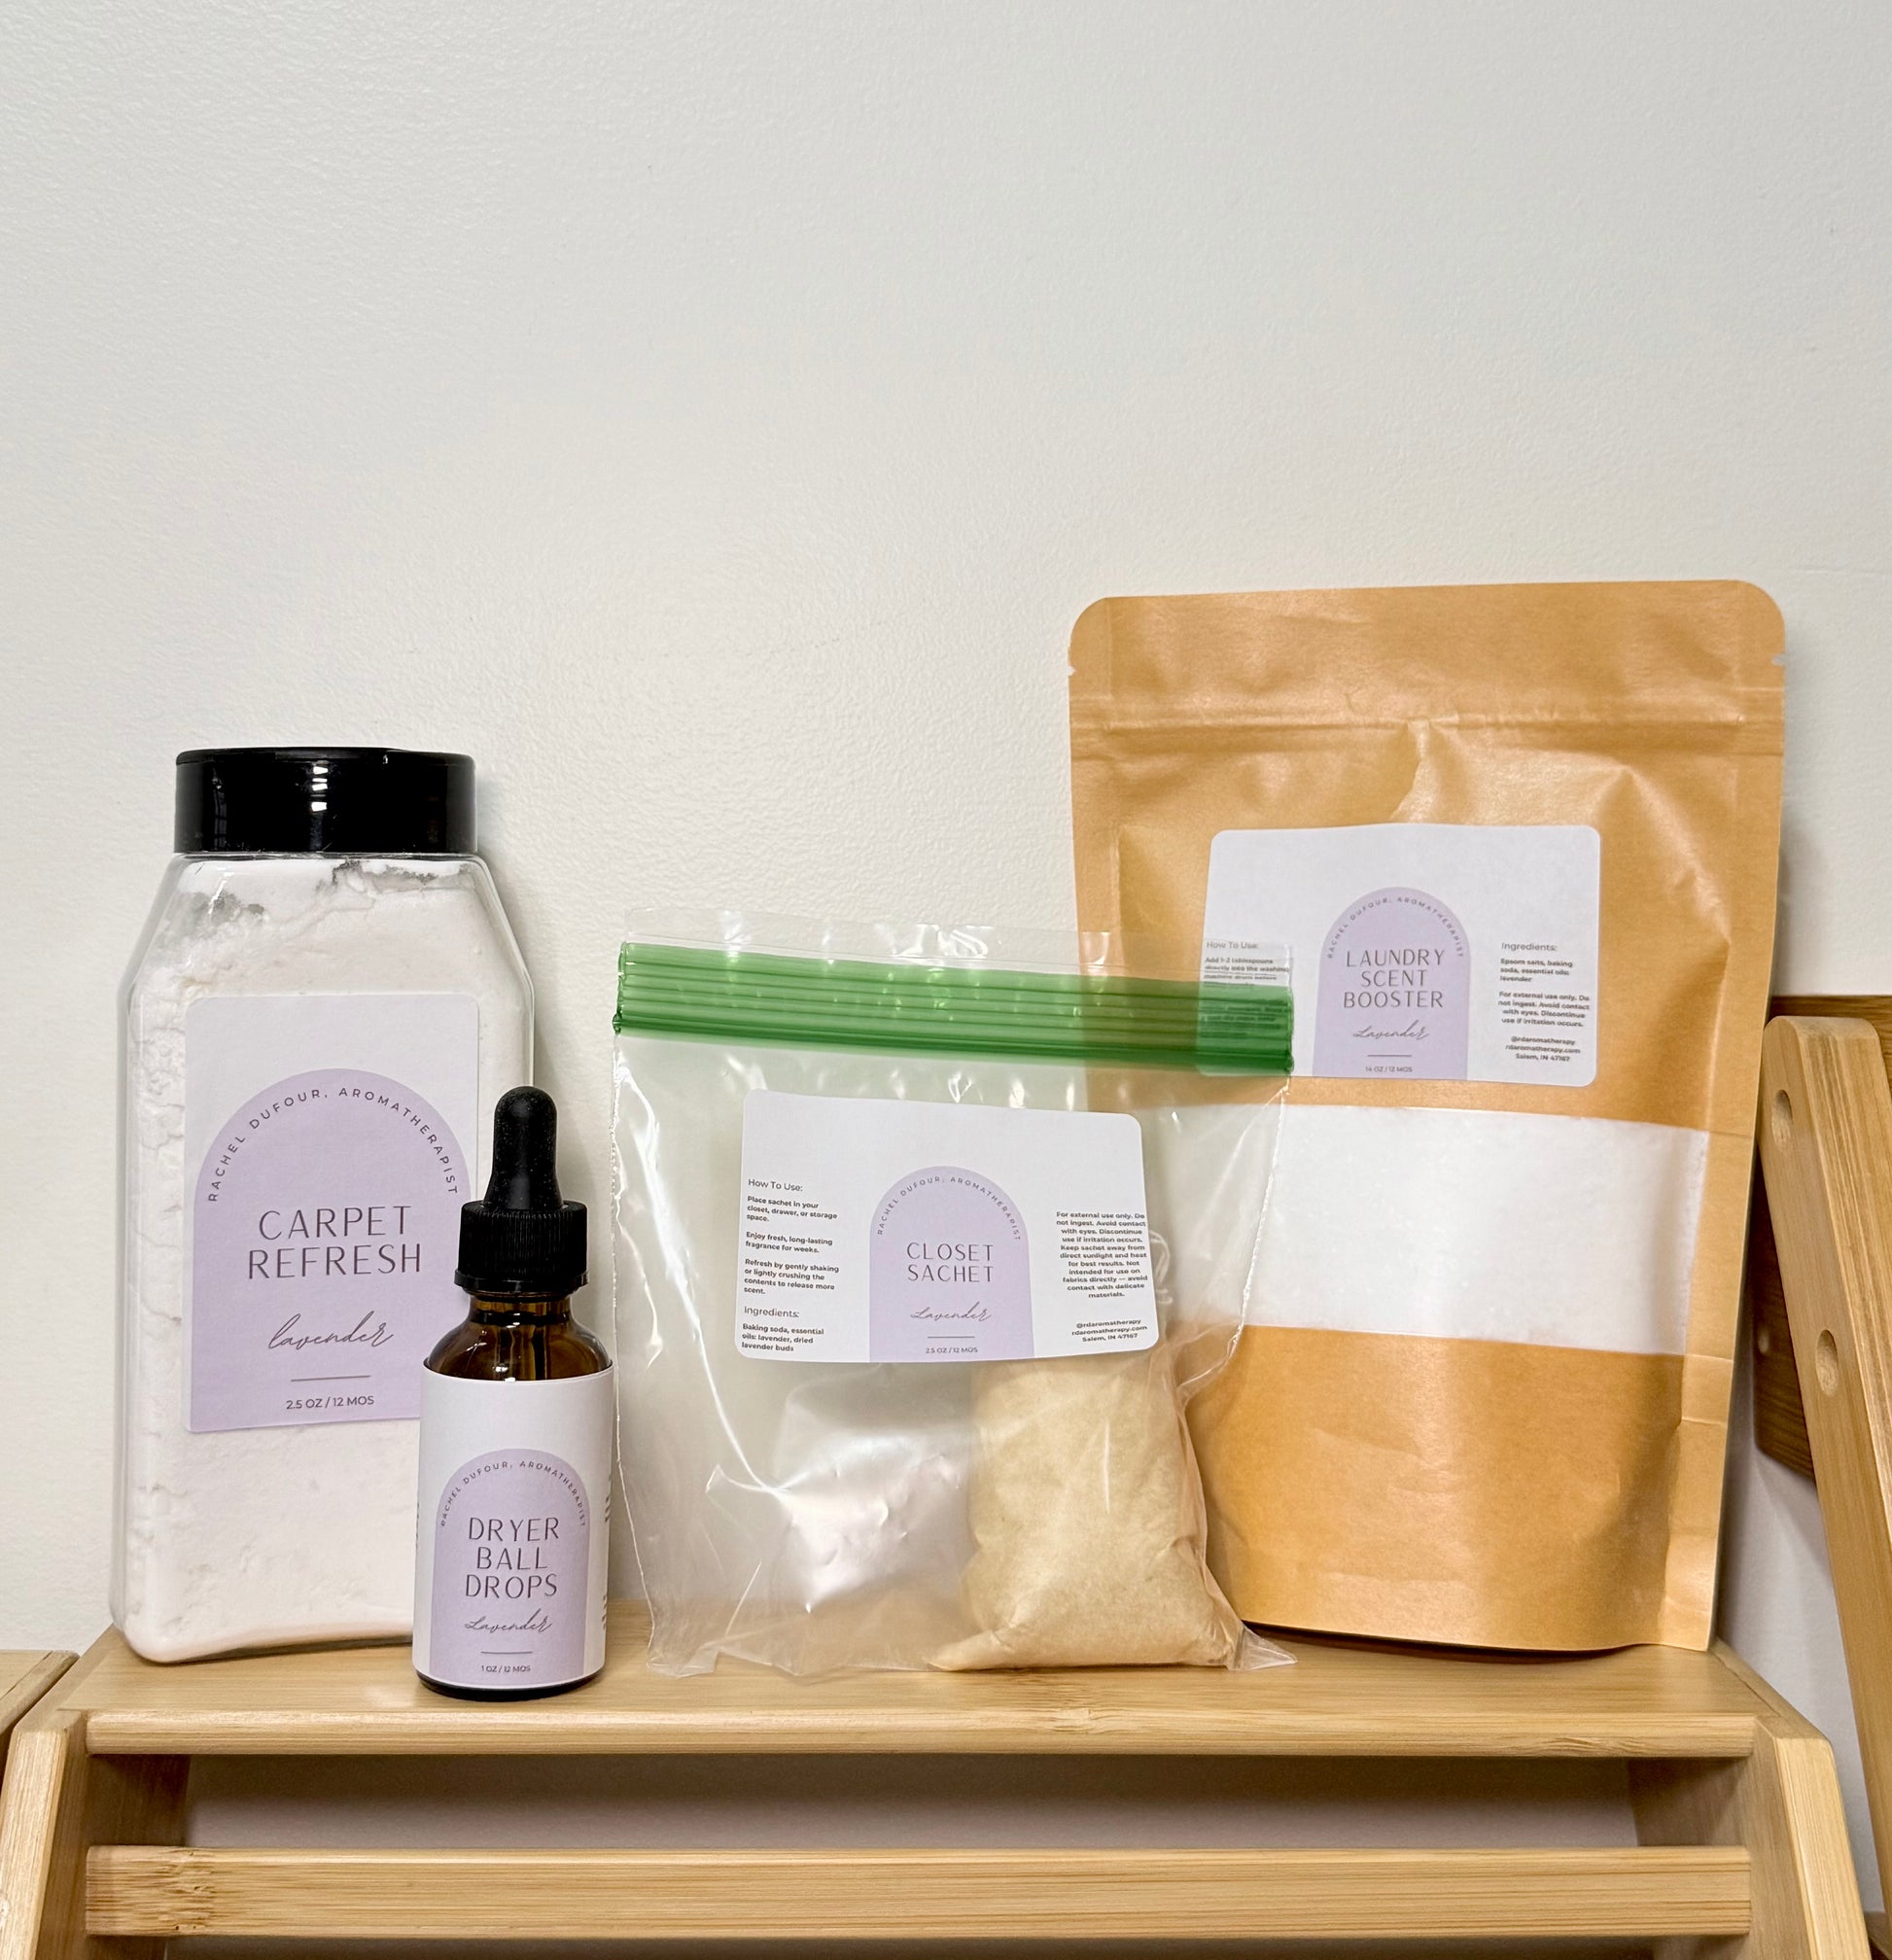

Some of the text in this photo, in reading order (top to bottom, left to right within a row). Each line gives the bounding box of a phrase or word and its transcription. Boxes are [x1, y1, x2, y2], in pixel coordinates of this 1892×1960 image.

[1327, 896, 1463, 959] RACHEL DUFOUR, AROMATHERAPIST
[1346, 949, 1445, 966] LAUNDRY
[1361, 969, 1427, 988] SCENT
[1344, 991, 1444, 1008] BOOSTER
[1352, 1020, 1430, 1039] Lavender
[208, 1088, 458, 1203] RACHEL DUFOUR, AROMATHERAPIST
[749, 1178, 803, 1192] How To Use:
[747, 1205, 770, 1214] closet,
[878, 1176, 1021, 1241] RACHEL DUFOUR, AROMATHERAPIST
[259, 1206, 411, 1241] CARPET
[746, 1241, 780, 1250] fragrance
[747, 1231, 832, 1245] Enjoy fresh, long-lasting
[248, 1243, 421, 1279] REFRESH
[906, 1242, 994, 1261] CLOSET
[745, 1258, 772, 1268] Refresh
[774, 1261, 784, 1270] by
[810, 1265, 839, 1274] shaking
[753, 1269, 777, 1278] lightly
[778, 1272, 811, 1280] crushing
[908, 1264, 994, 1282] SACHET
[745, 1307, 799, 1317] Ingredients:
[910, 1301, 992, 1321] Lavender
[268, 1311, 394, 1349] lavender
[743, 1323, 768, 1333] Baking
[742, 1342, 774, 1350] lavender
[286, 1399, 302, 1410] 2.5
[305, 1398, 323, 1410] OZ
[333, 1397, 343, 1408] 12
[347, 1395, 374, 1407] MOS
[440, 1487, 461, 1527] RACHEL
[463, 1461, 513, 1484] DUFOUR,
[520, 1460, 586, 1527] AROMATHERAPIST
[469, 1518, 560, 1542] DRYER
[476, 1546, 547, 1570] BALL
[466, 1574, 557, 1598] DROPS
[465, 1608, 553, 1633] Lavender
